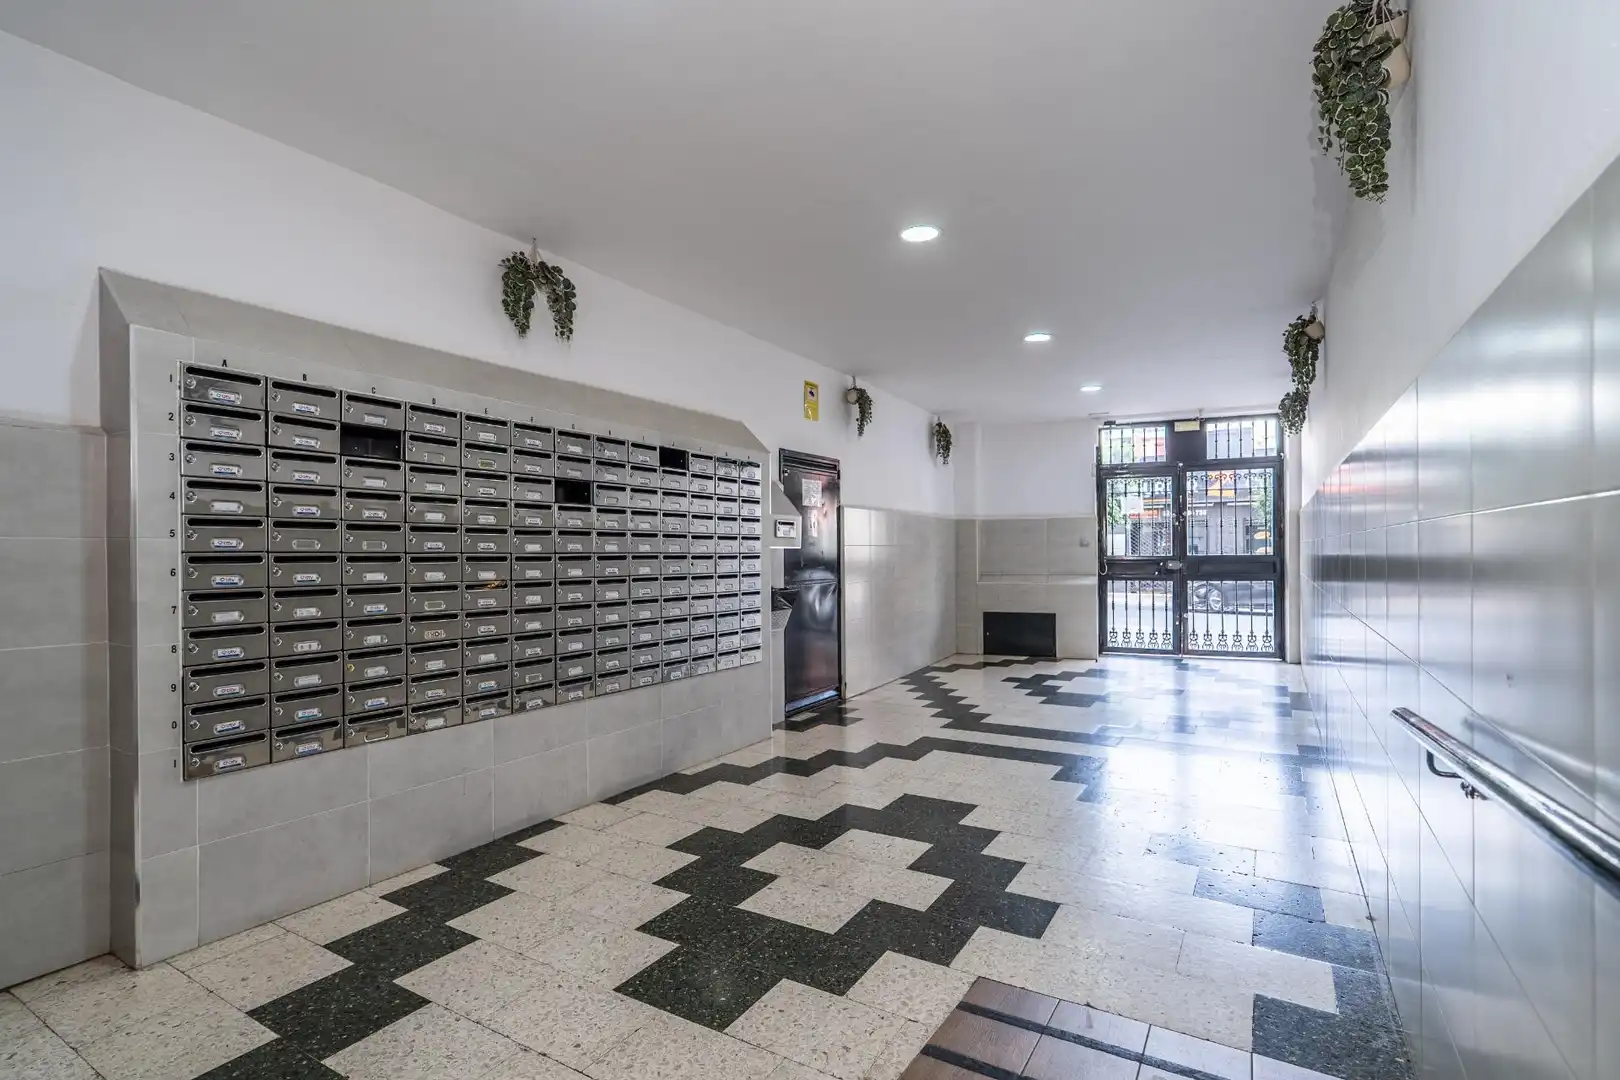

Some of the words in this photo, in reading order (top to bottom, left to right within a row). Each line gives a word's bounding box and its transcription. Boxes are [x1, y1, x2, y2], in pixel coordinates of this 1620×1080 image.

[221, 358, 229, 368] A
[302, 373, 308, 382] B
[371, 386, 377, 395] C
[167, 411, 175, 422] 2
[168, 452, 175, 462] 3
[168, 491, 176, 501] 4
[168, 528, 176, 539] 5
[169, 567, 177, 577] 6
[170, 605, 178, 615] 7
[170, 644, 178, 654] 8
[170, 683, 177, 693] 9
